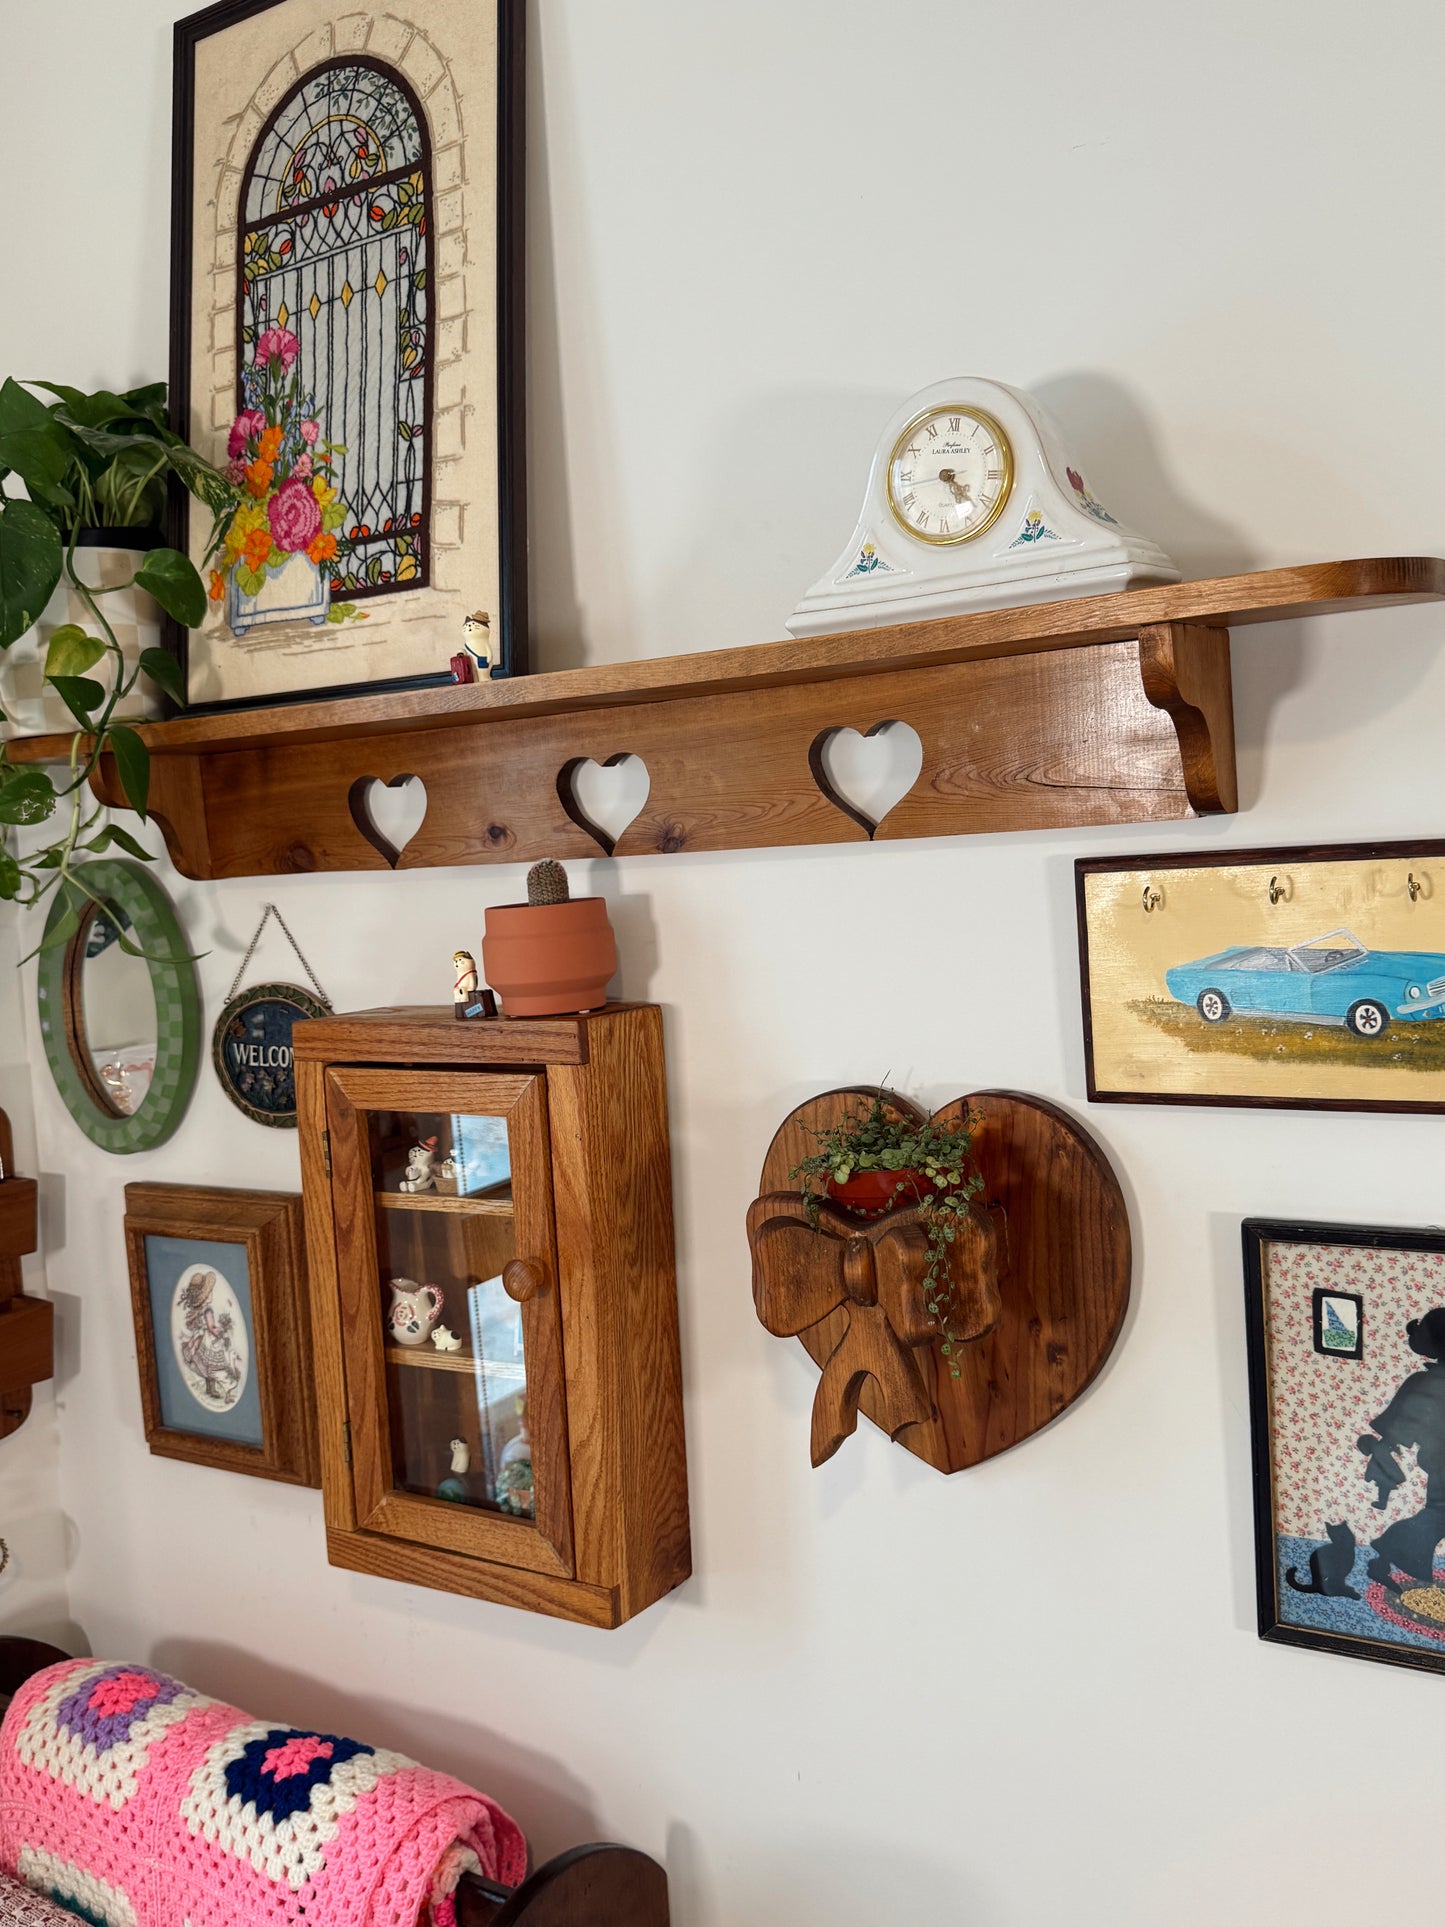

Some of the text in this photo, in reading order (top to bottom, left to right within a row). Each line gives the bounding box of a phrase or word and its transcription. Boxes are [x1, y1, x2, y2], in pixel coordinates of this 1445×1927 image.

[947, 418, 960, 432] XII
[971, 425, 979, 437] I
[925, 424, 938, 441] XI
[907, 443, 921, 459] X
[983, 444, 994, 456] II
[900, 470, 912, 482] IX
[987, 470, 1001, 480] III
[902, 492, 916, 511] VIII
[979, 494, 993, 509] IV
[916, 511, 930, 528] VII
[939, 519, 950, 533] VI
